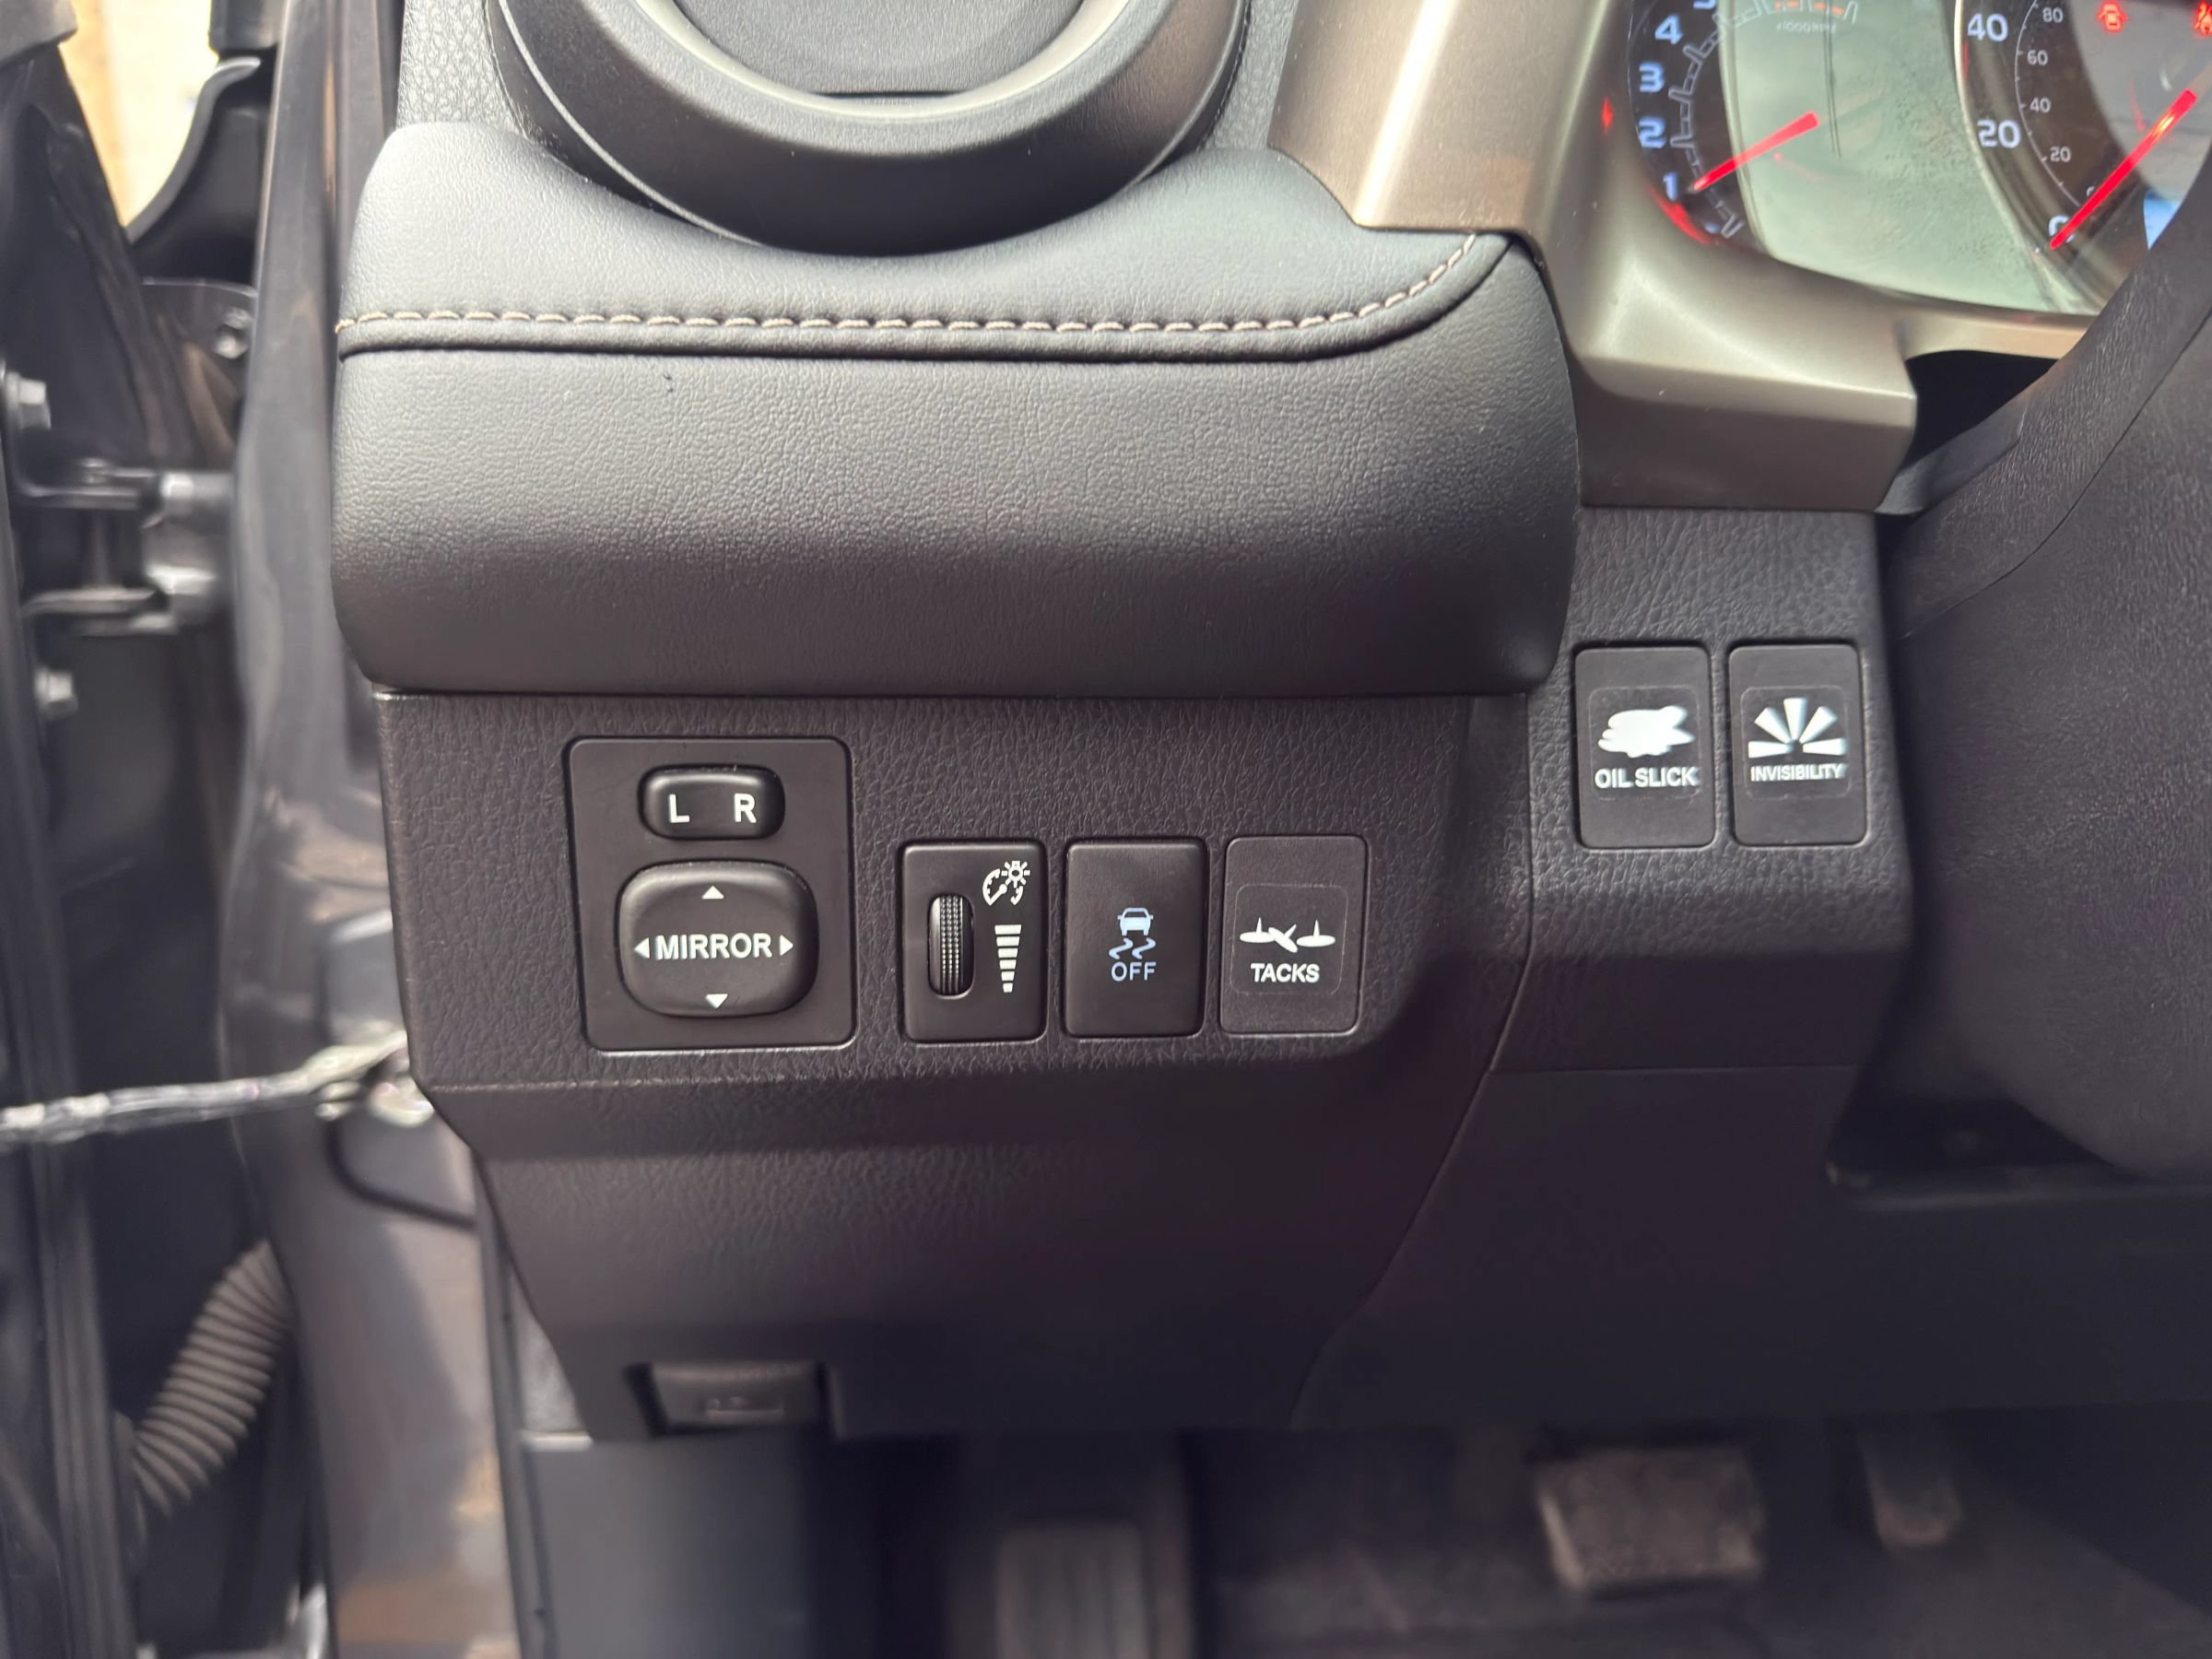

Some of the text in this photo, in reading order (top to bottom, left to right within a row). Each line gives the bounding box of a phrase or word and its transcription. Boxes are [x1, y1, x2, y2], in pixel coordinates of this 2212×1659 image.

[1967, 13, 2008, 41] 40
[2042, 7, 2064, 23] 80
[1654, 15, 1683, 44] 4
[2027, 50, 2048, 65] 60
[1639, 61, 1665, 92] 3
[2030, 97, 2052, 113] 40
[1639, 117, 1665, 148] 2
[1977, 119, 2021, 148] 20
[2050, 147, 2071, 162] 20
[1663, 171, 1678, 201] 1
[1594, 766, 1700, 788] OIL SLICK
[1750, 763, 1846, 782] INVISIBILITY
[668, 793, 757, 823] L R
[655, 933, 772, 959] MIRROR
[1111, 961, 1157, 982] OFF
[1251, 963, 1320, 982] TACKS
